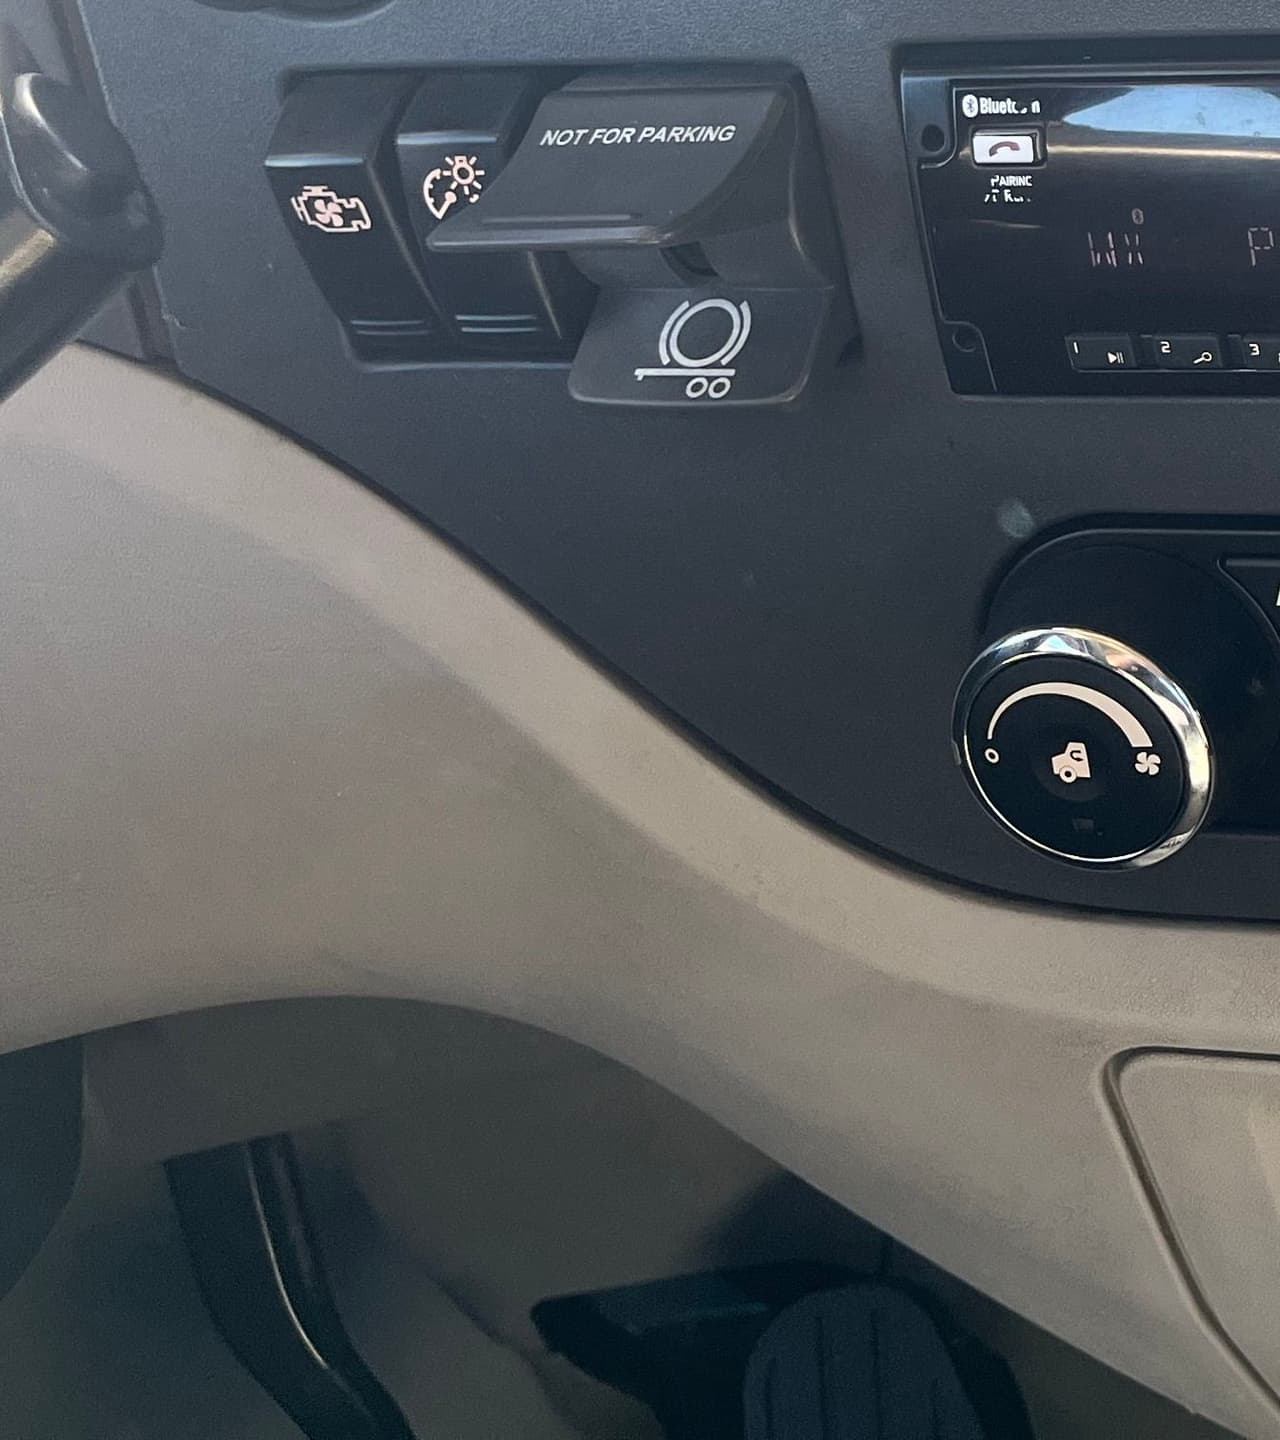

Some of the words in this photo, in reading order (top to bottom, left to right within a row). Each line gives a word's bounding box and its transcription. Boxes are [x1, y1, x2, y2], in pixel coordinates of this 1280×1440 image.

[540, 129, 589, 146] NOT
[589, 127, 635, 145] FOR
[637, 125, 736, 143] PARKING
[1074, 341, 1080, 355] 1
[1161, 341, 1171, 354] 2
[1249, 343, 1260, 356] 3
